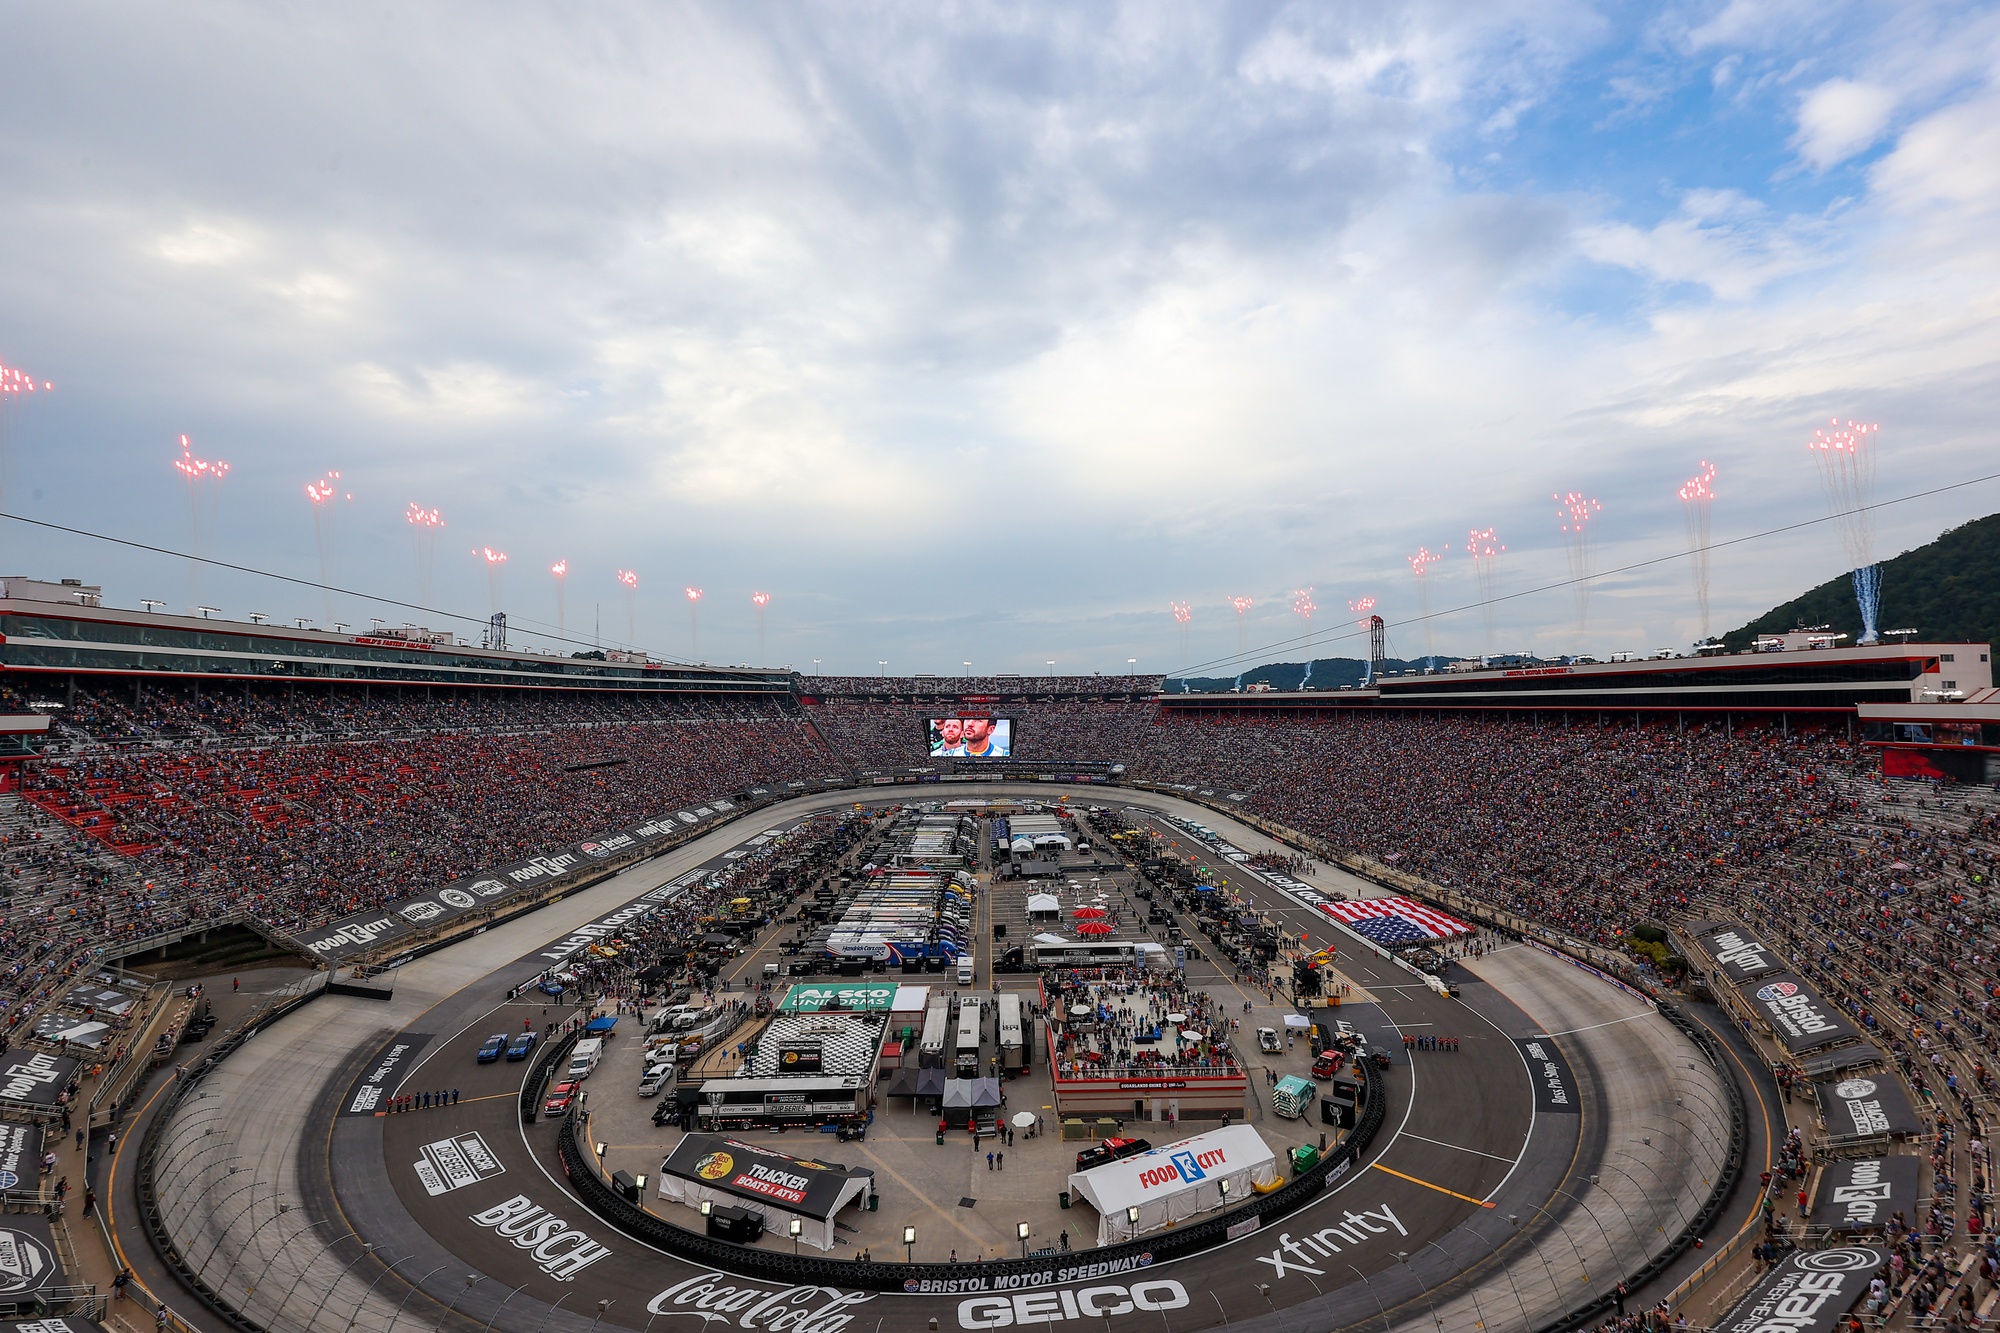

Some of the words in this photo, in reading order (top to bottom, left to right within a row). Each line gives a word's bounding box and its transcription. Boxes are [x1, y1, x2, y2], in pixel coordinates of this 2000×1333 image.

[355, 637, 382, 645] WORLD'S
[382, 639, 406, 647] FASTEST
[635, 825, 658, 838] FOOD
[662, 818, 678, 830] CITY
[601, 832, 632, 849] Bristol
[508, 864, 544, 883] FOOD
[555, 852, 579, 867] CITY
[476, 879, 504, 896] BUSH'S
[405, 902, 442, 921] BUSH'S
[602, 903, 653, 925] FOOD
[306, 934, 350, 954] FOOD
[364, 917, 396, 934] CITY
[540, 935, 594, 960] CITY
[1308, 953, 1339, 961] SUNOCO
[1713, 931, 1745, 950] FOOD
[1735, 953, 1769, 972] CITY
[791, 989, 886, 998] ALSCO
[791, 998, 886, 1006] UNIORMS
[1777, 993, 1839, 1035] Bristol
[27, 1052, 59, 1070] CITY
[382, 1057, 400, 1067] Pro
[389, 1044, 411, 1058] Bass
[368, 1066, 393, 1083] Shops
[1543, 1061, 1560, 1079] Shops
[1547, 1078, 1563, 1089] Pro
[779, 1095, 806, 1103] NASCAR
[1551, 1088, 1569, 1105] Bass
[1863, 1099, 1891, 1132] TRACKER
[6, 1127, 28, 1154] Speedway
[1, 1152, 20, 1172] Motor
[436, 1146, 457, 1159] CUP
[460, 1138, 496, 1172] NASCAR
[715, 1153, 731, 1163] Bass
[443, 1158, 470, 1180] SERIES
[704, 1166, 725, 1179] Shops
[710, 1160, 722, 1170] Pro
[1138, 1164, 1178, 1190] FOOD
[1196, 1148, 1227, 1170] CITY
[1851, 1160, 1881, 1185] FOOD
[419, 1166, 441, 1189] PLAYOFFS
[747, 1163, 809, 1191] TRACKER
[737, 1175, 768, 1195] BOATS
[775, 1188, 801, 1202] ATVs
[1843, 1200, 1878, 1224] CITY
[468, 1193, 614, 1282] BUSCH
[1255, 1203, 1409, 1280] xfinity
[919, 1277, 990, 1293] BRISTOL
[993, 1271, 1053, 1290] MOTOR
[1057, 1254, 1141, 1282] SPEEDWAY
[1762, 1271, 1804, 1301] WATER
[646, 1272, 878, 1333] Coca-Cola
[957, 1279, 1191, 1330] GEICO
